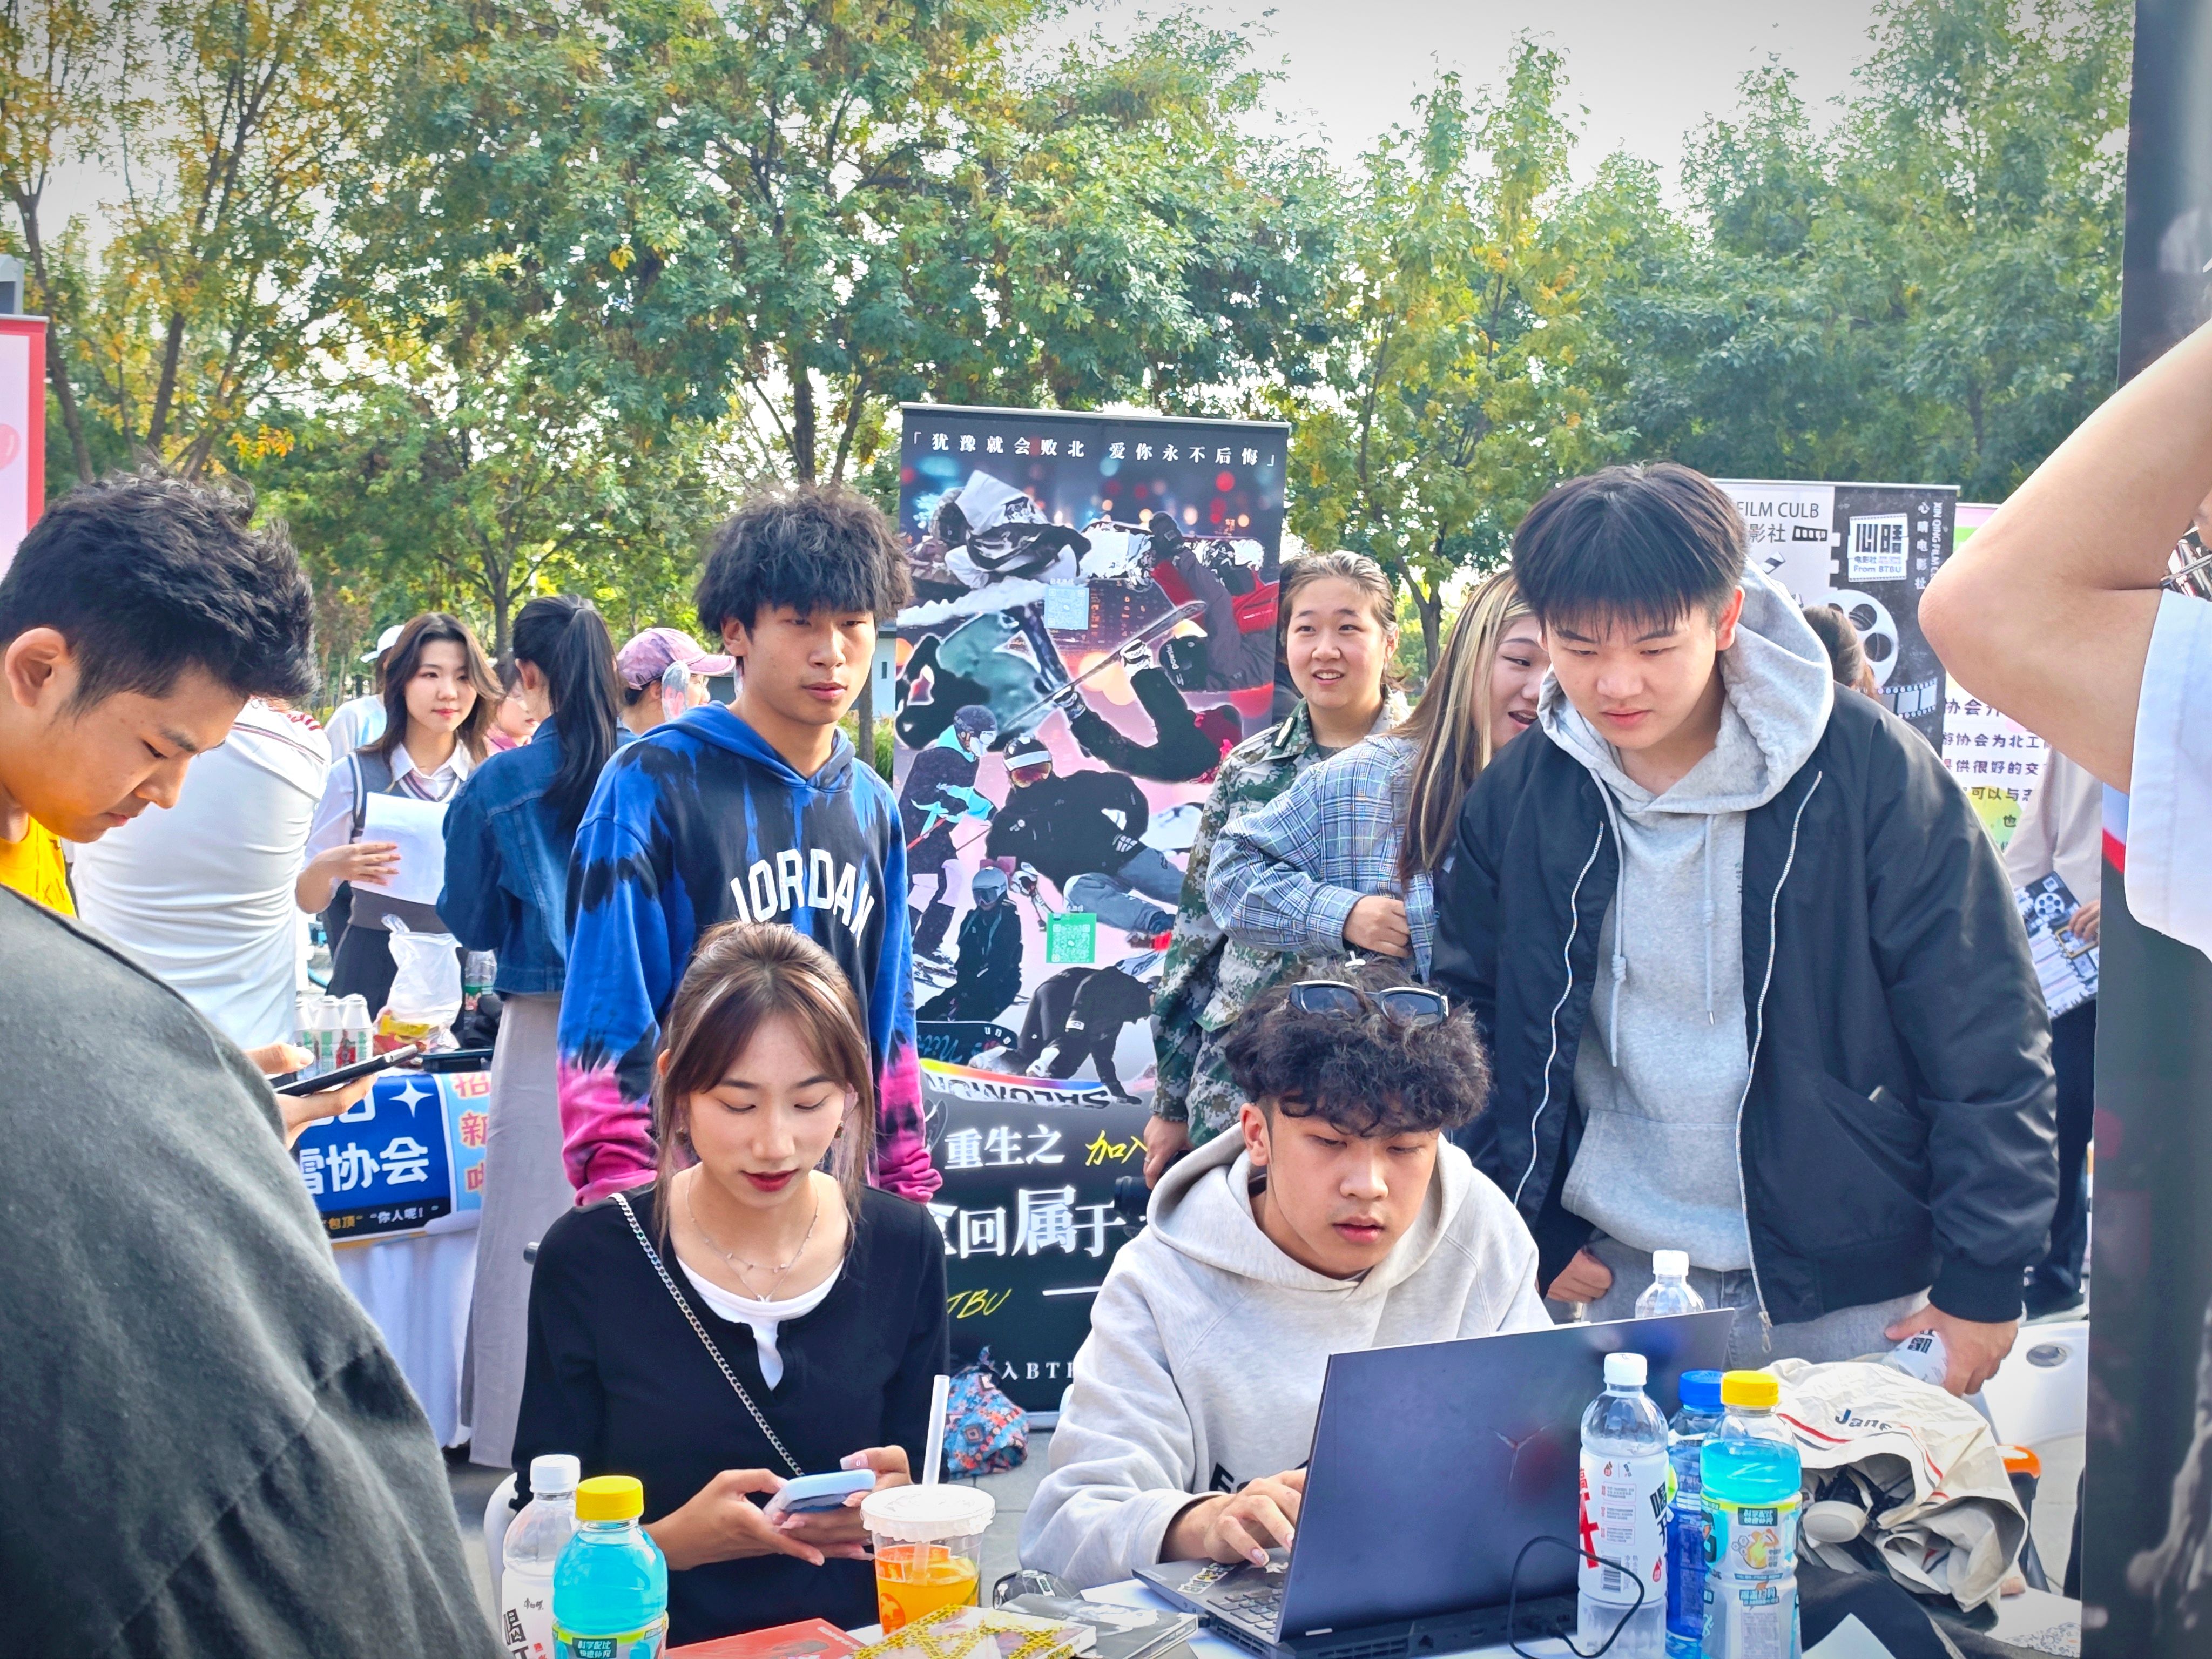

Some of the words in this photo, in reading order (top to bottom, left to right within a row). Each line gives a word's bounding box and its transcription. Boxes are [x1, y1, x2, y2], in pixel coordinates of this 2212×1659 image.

[1737, 501, 1773, 517] FILM
[1778, 502, 1819, 518] CULB
[1749, 523, 1786, 543] 影社
[1943, 733, 2048, 750] 游协会为北工
[730, 848, 875, 948] JORDAN
[943, 1124, 1066, 1170] 重生之
[1085, 1129, 1149, 1166] 加入
